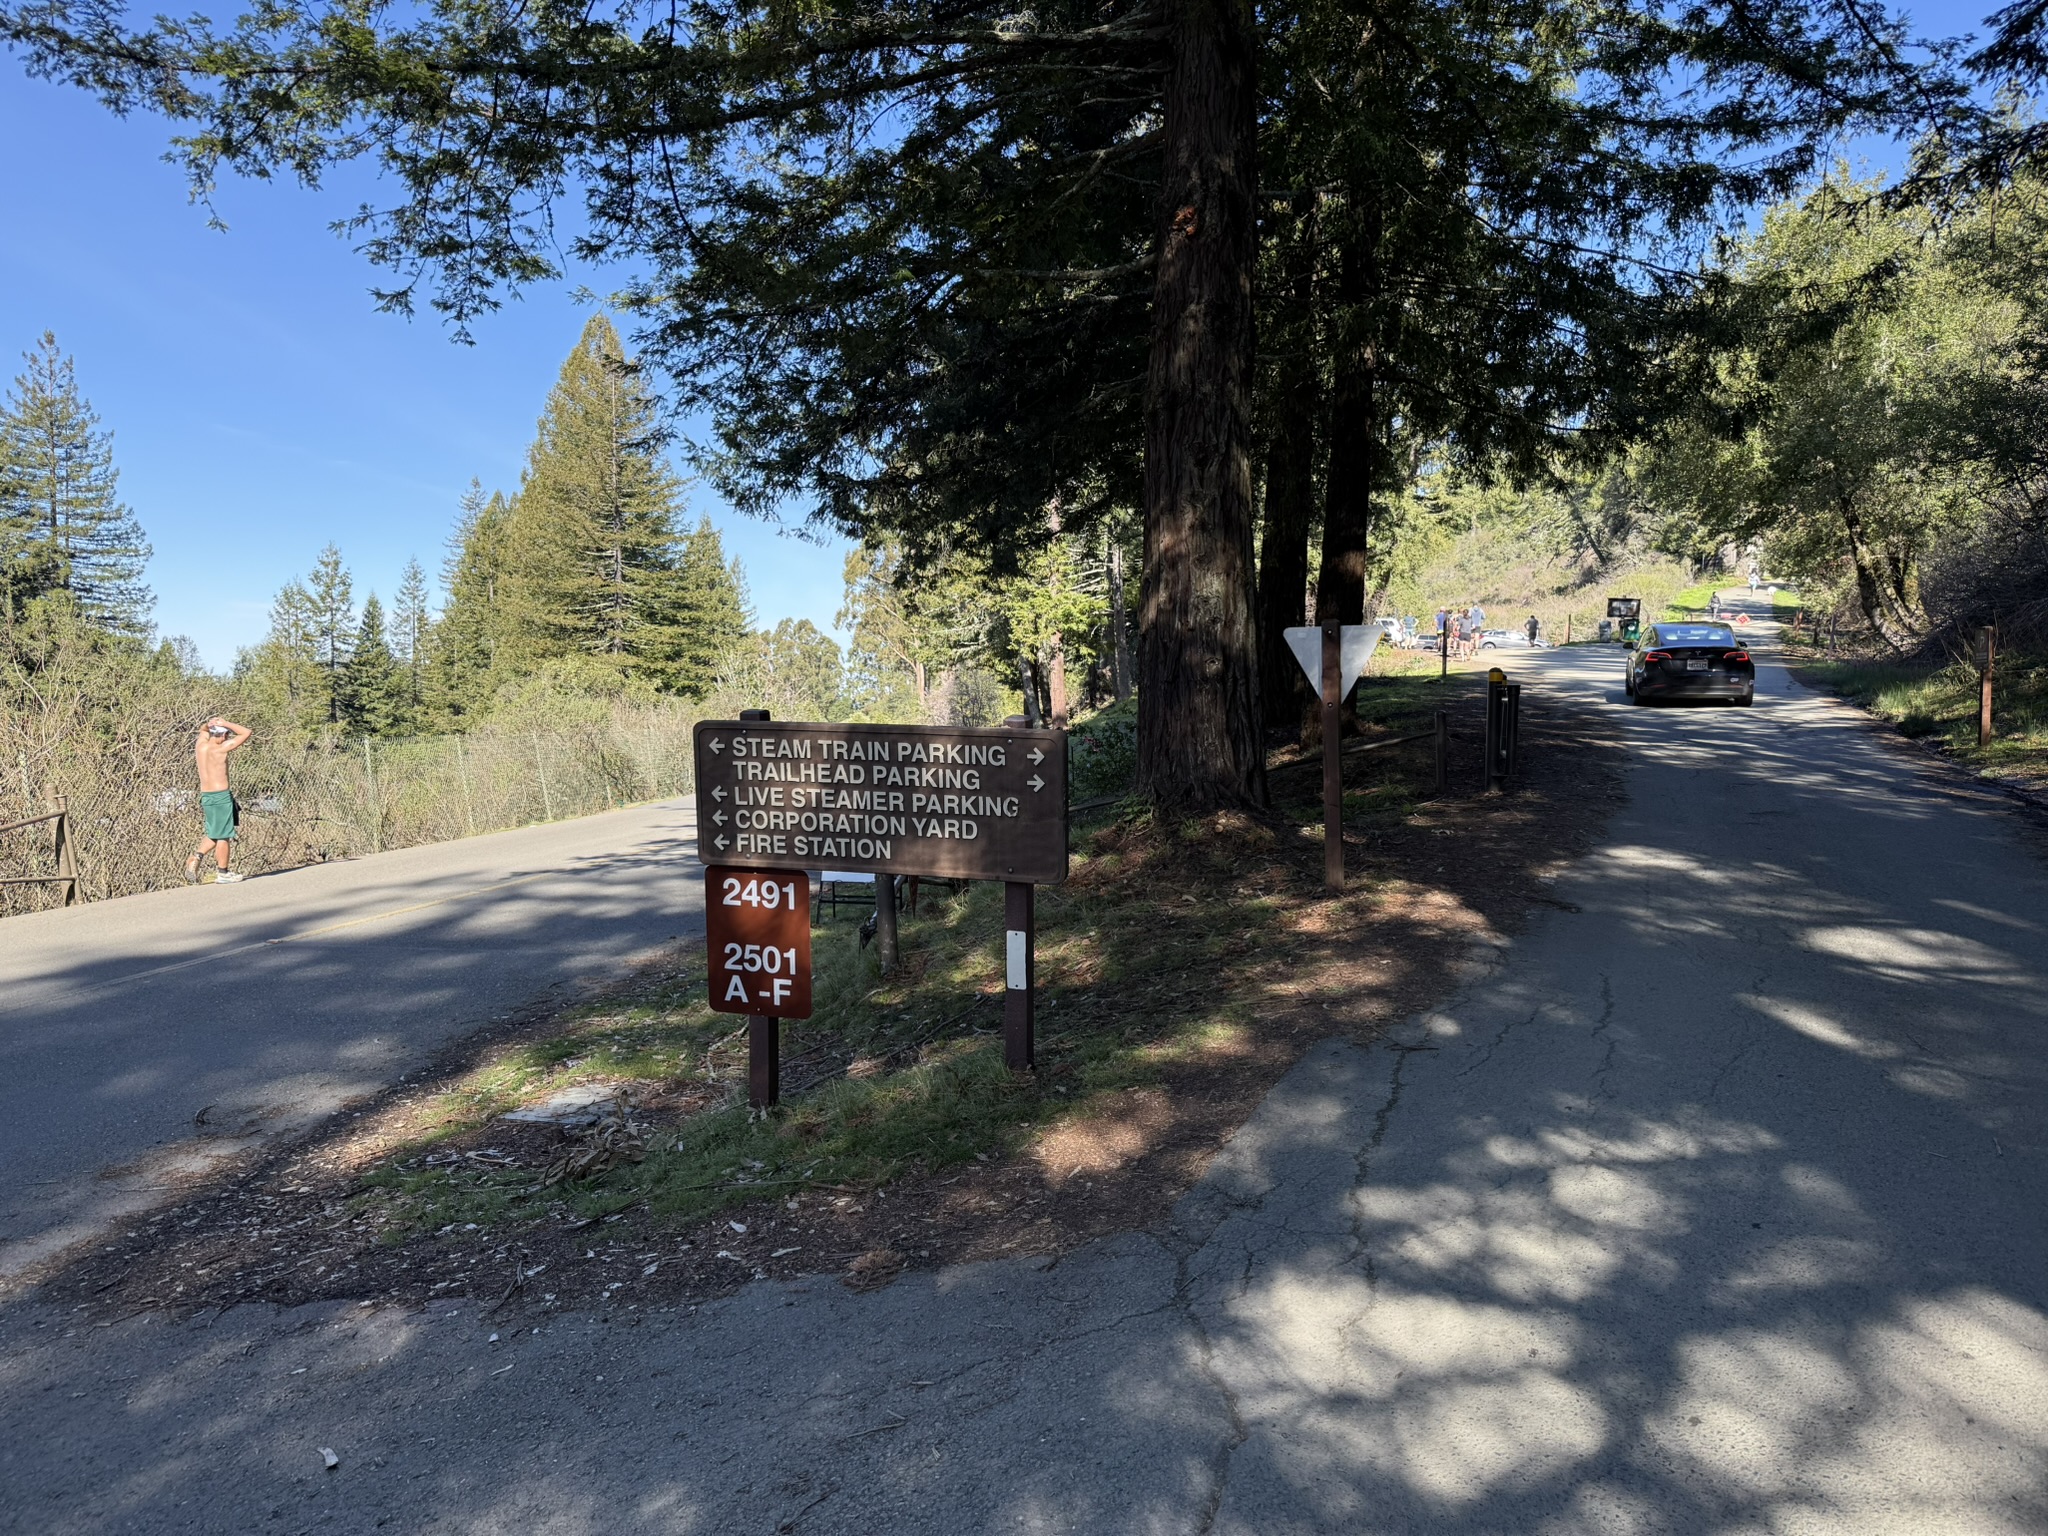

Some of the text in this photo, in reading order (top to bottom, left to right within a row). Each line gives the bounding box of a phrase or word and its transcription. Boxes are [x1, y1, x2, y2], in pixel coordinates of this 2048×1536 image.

[732, 737, 1006, 766] STEAM TRAIN PARKING
[733, 761, 980, 790] TRAILHEAD PARKING
[734, 787, 1019, 817] LIVE STEAMER PARKING
[735, 810, 978, 840] CORPORATION YARD
[736, 834, 891, 860] FIRE STATION
[722, 878, 795, 910] 2491
[724, 943, 796, 975] 2501
[725, 975, 749, 1003] A
